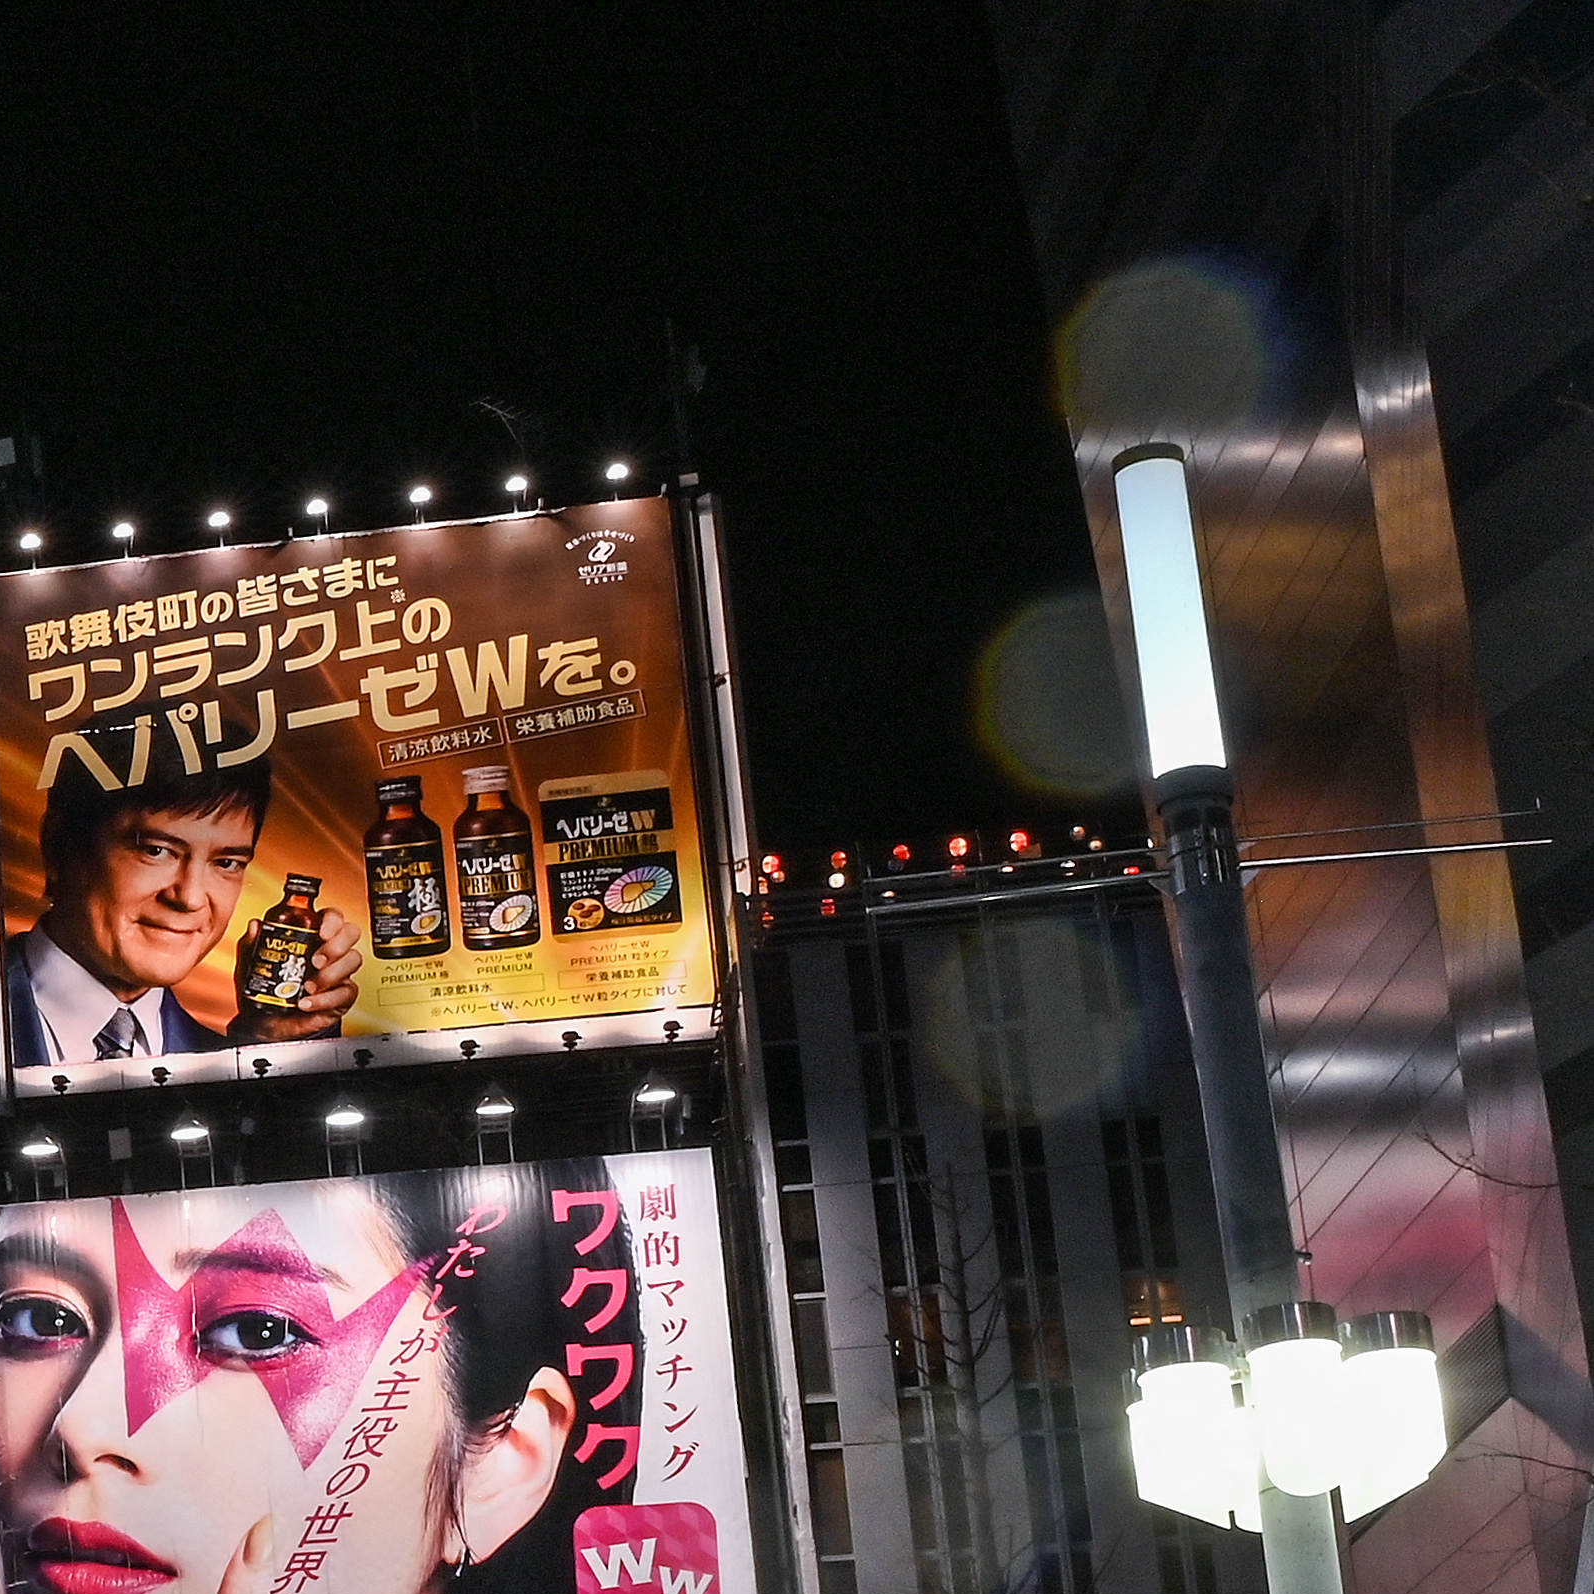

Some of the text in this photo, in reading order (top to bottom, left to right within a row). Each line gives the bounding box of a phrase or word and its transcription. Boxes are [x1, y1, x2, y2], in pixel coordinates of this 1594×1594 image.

[24, 555, 401, 663] 歌舞伎町の皆さまに
[34, 634, 638, 792] ヘパリーゼWを。
[387, 697, 637, 762] 清涼飲料水 栄養補助食品
[557, 835, 639, 863] PREMIUM
[407, 878, 442, 912] 極
[476, 962, 533, 975] PREMIUM
[570, 954, 629, 967] PREMIUM
[585, 967, 661, 985] 栄養補助食品
[380, 972, 437, 985] PREMIUM
[429, 982, 494, 999] 清涼飲料水
[551, 1188, 641, 1492] ワクワク
[637, 1184, 703, 1483] 劇的マッチング
